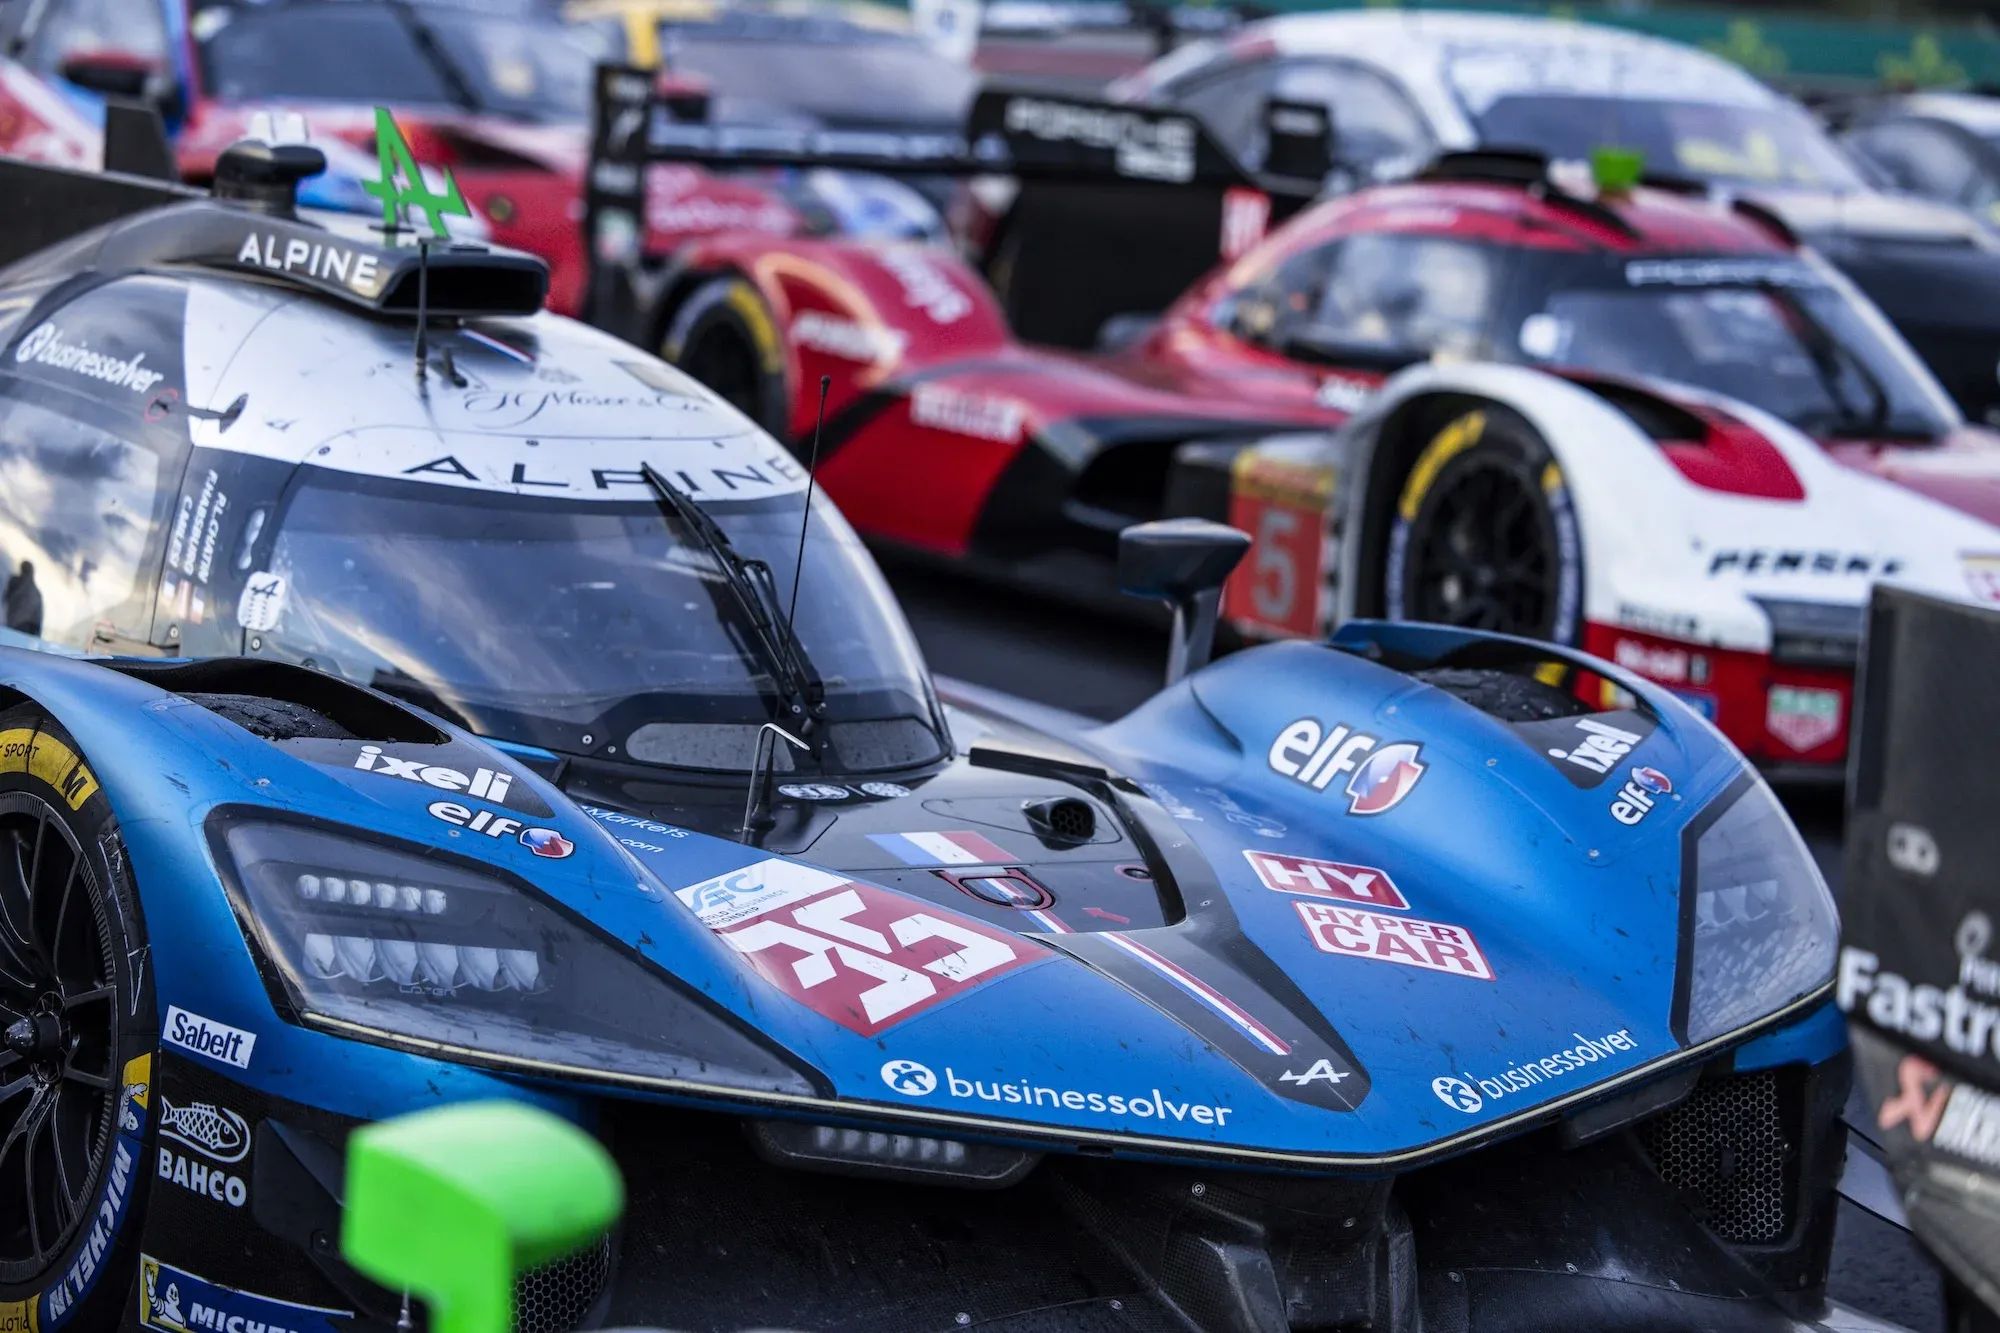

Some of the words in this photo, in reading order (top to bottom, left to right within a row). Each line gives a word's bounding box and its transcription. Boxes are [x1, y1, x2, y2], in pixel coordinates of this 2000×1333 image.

[238, 232, 379, 288] ALPINE
[36, 329, 164, 393] businessolver
[402, 455, 800, 490] ALPINE
[1253, 510, 1297, 624] 5
[4, 743, 40, 760] SPORT
[1269, 719, 1377, 790] elf
[428, 801, 522, 838] elf
[1610, 781, 1655, 825] elf
[1262, 858, 1378, 898] HY
[1306, 906, 1463, 944] HYPER
[1319, 923, 1479, 973] CAR
[718, 888, 1017, 1025] 35
[1837, 945, 2000, 1062] Fastr
[172, 1012, 243, 1062] Sabelt
[1465, 1027, 1639, 1101] businessolver
[945, 1067, 1233, 1126] businessolver
[158, 1146, 247, 1208] BAHCO
[50, 1139, 132, 1323] MICHELIN
[189, 1302, 299, 1333] MICH
